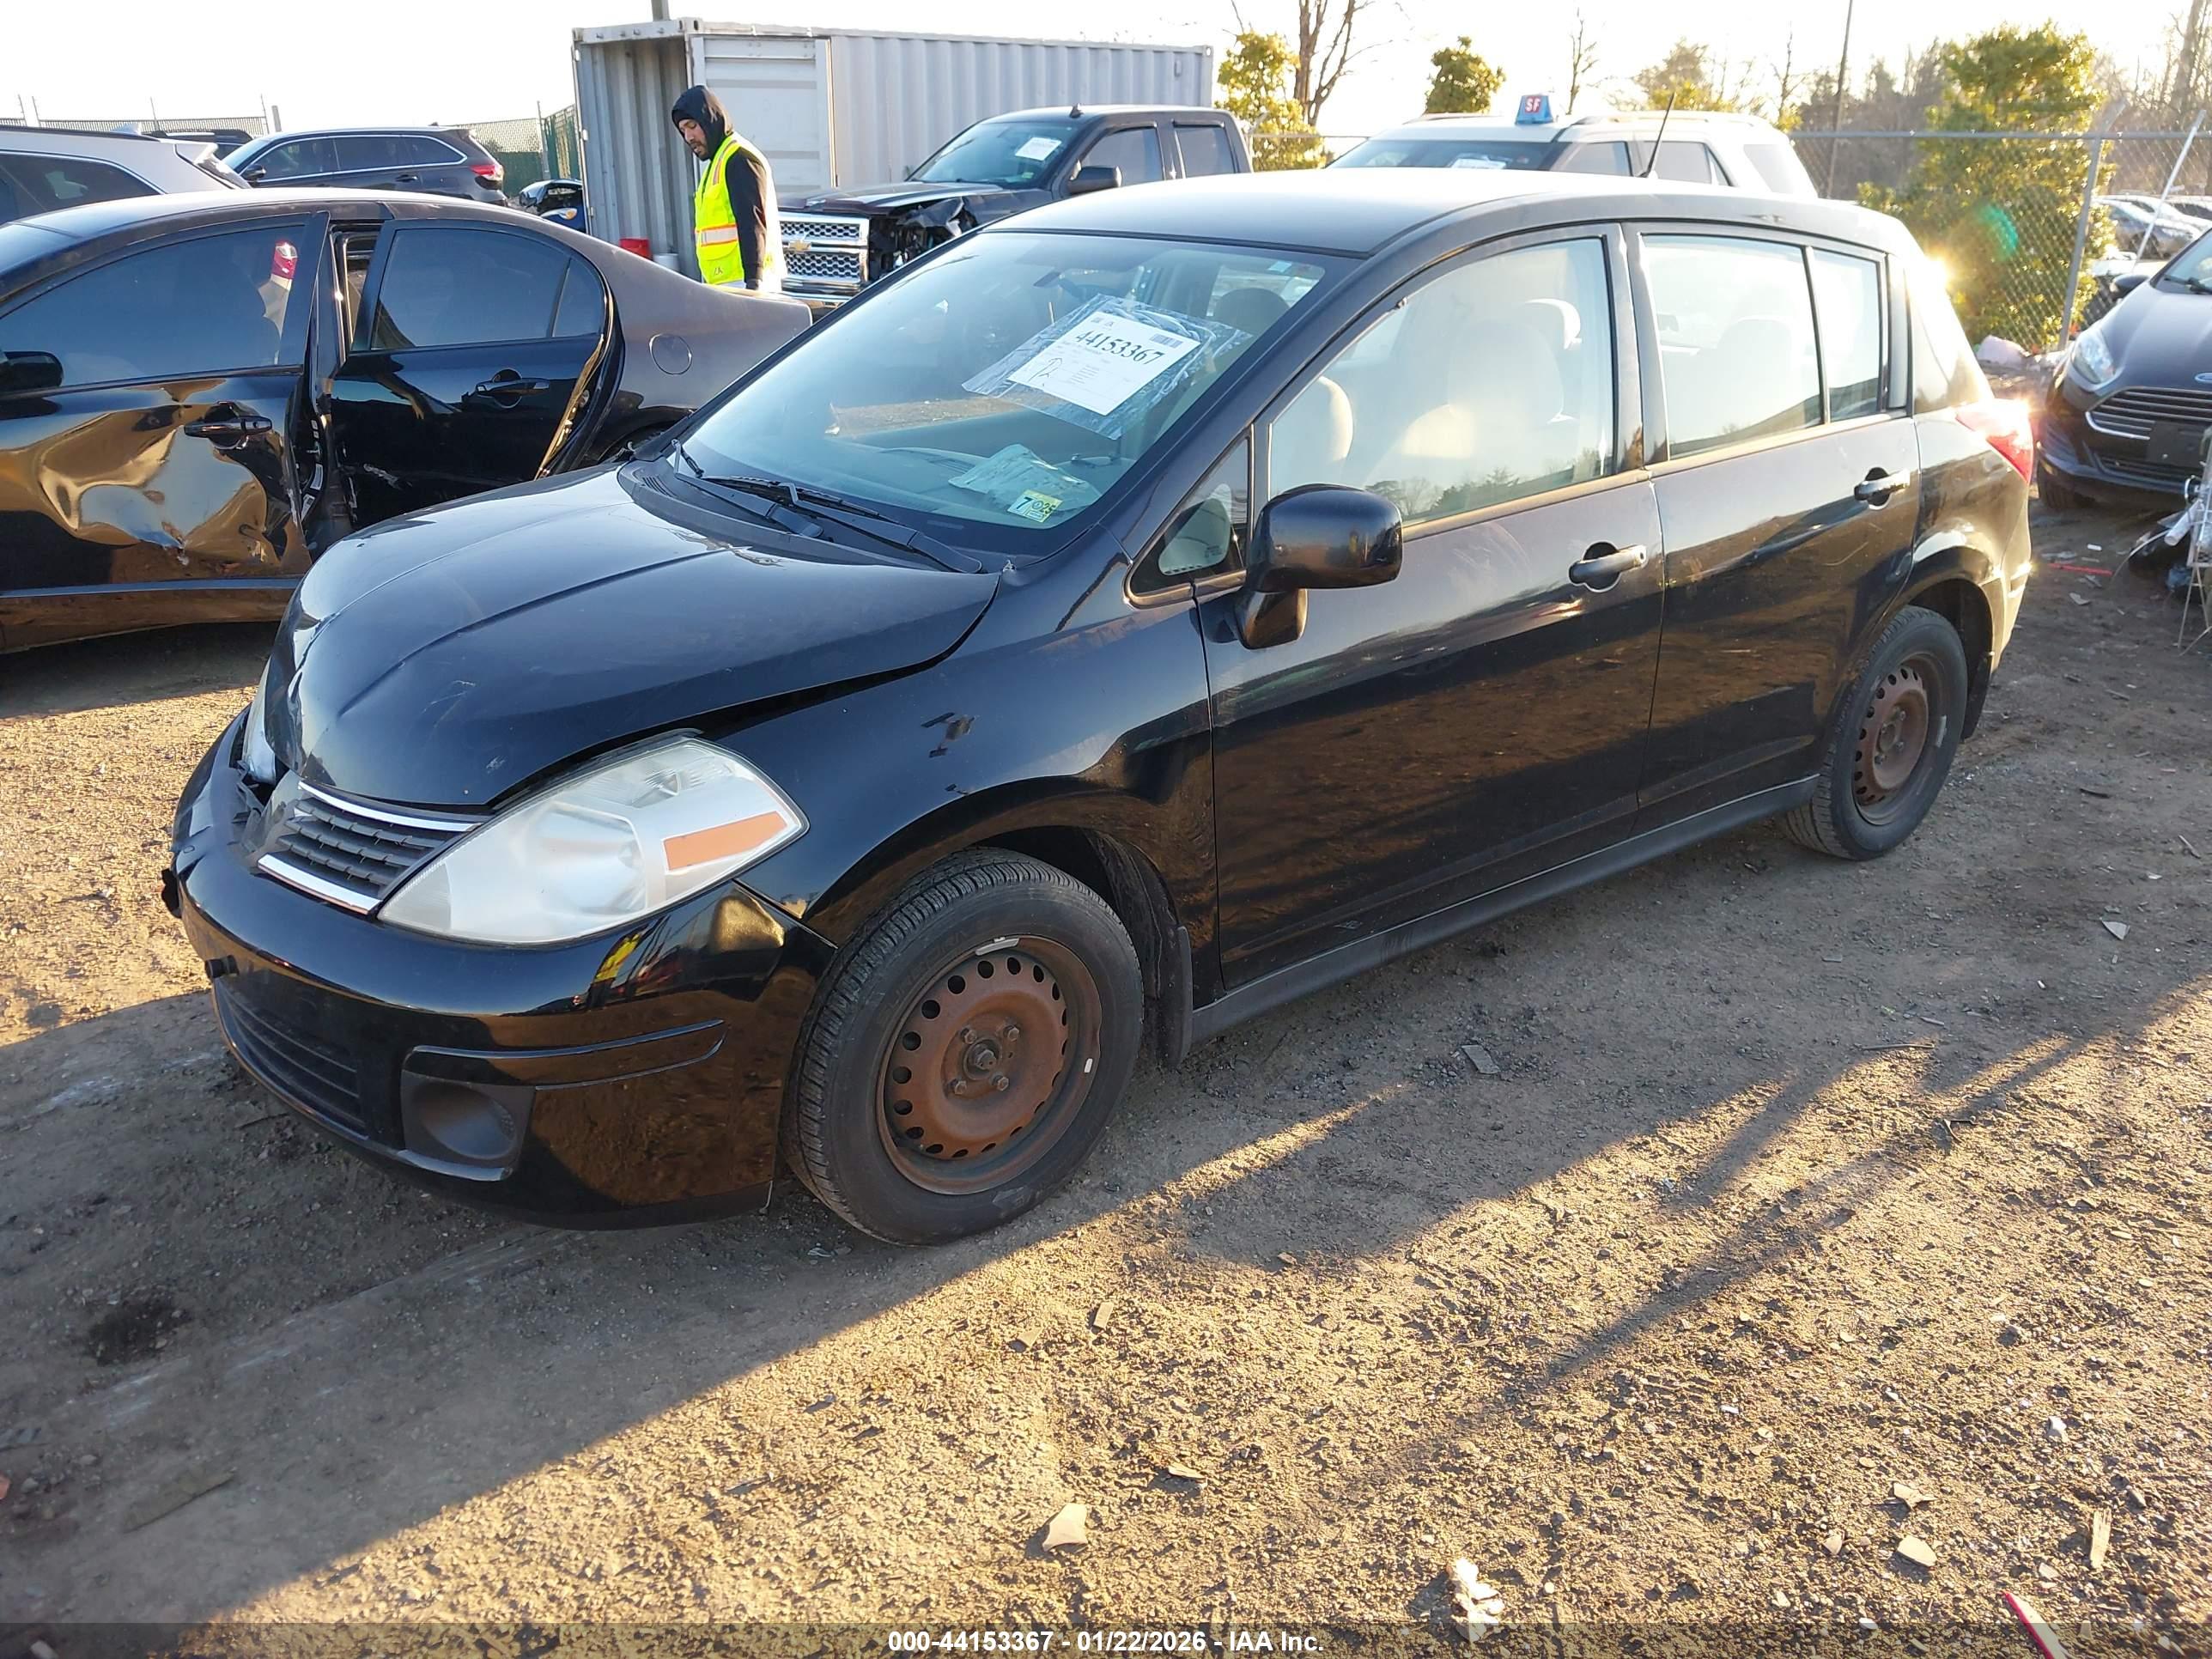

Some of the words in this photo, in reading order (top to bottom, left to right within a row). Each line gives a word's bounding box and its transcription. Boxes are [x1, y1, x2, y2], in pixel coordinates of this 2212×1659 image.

[1526, 98, 1541, 112] SF
[1075, 330, 1165, 365] 44153367
[1016, 496, 1034, 510] 7
[1039, 502, 1056, 514] 25
